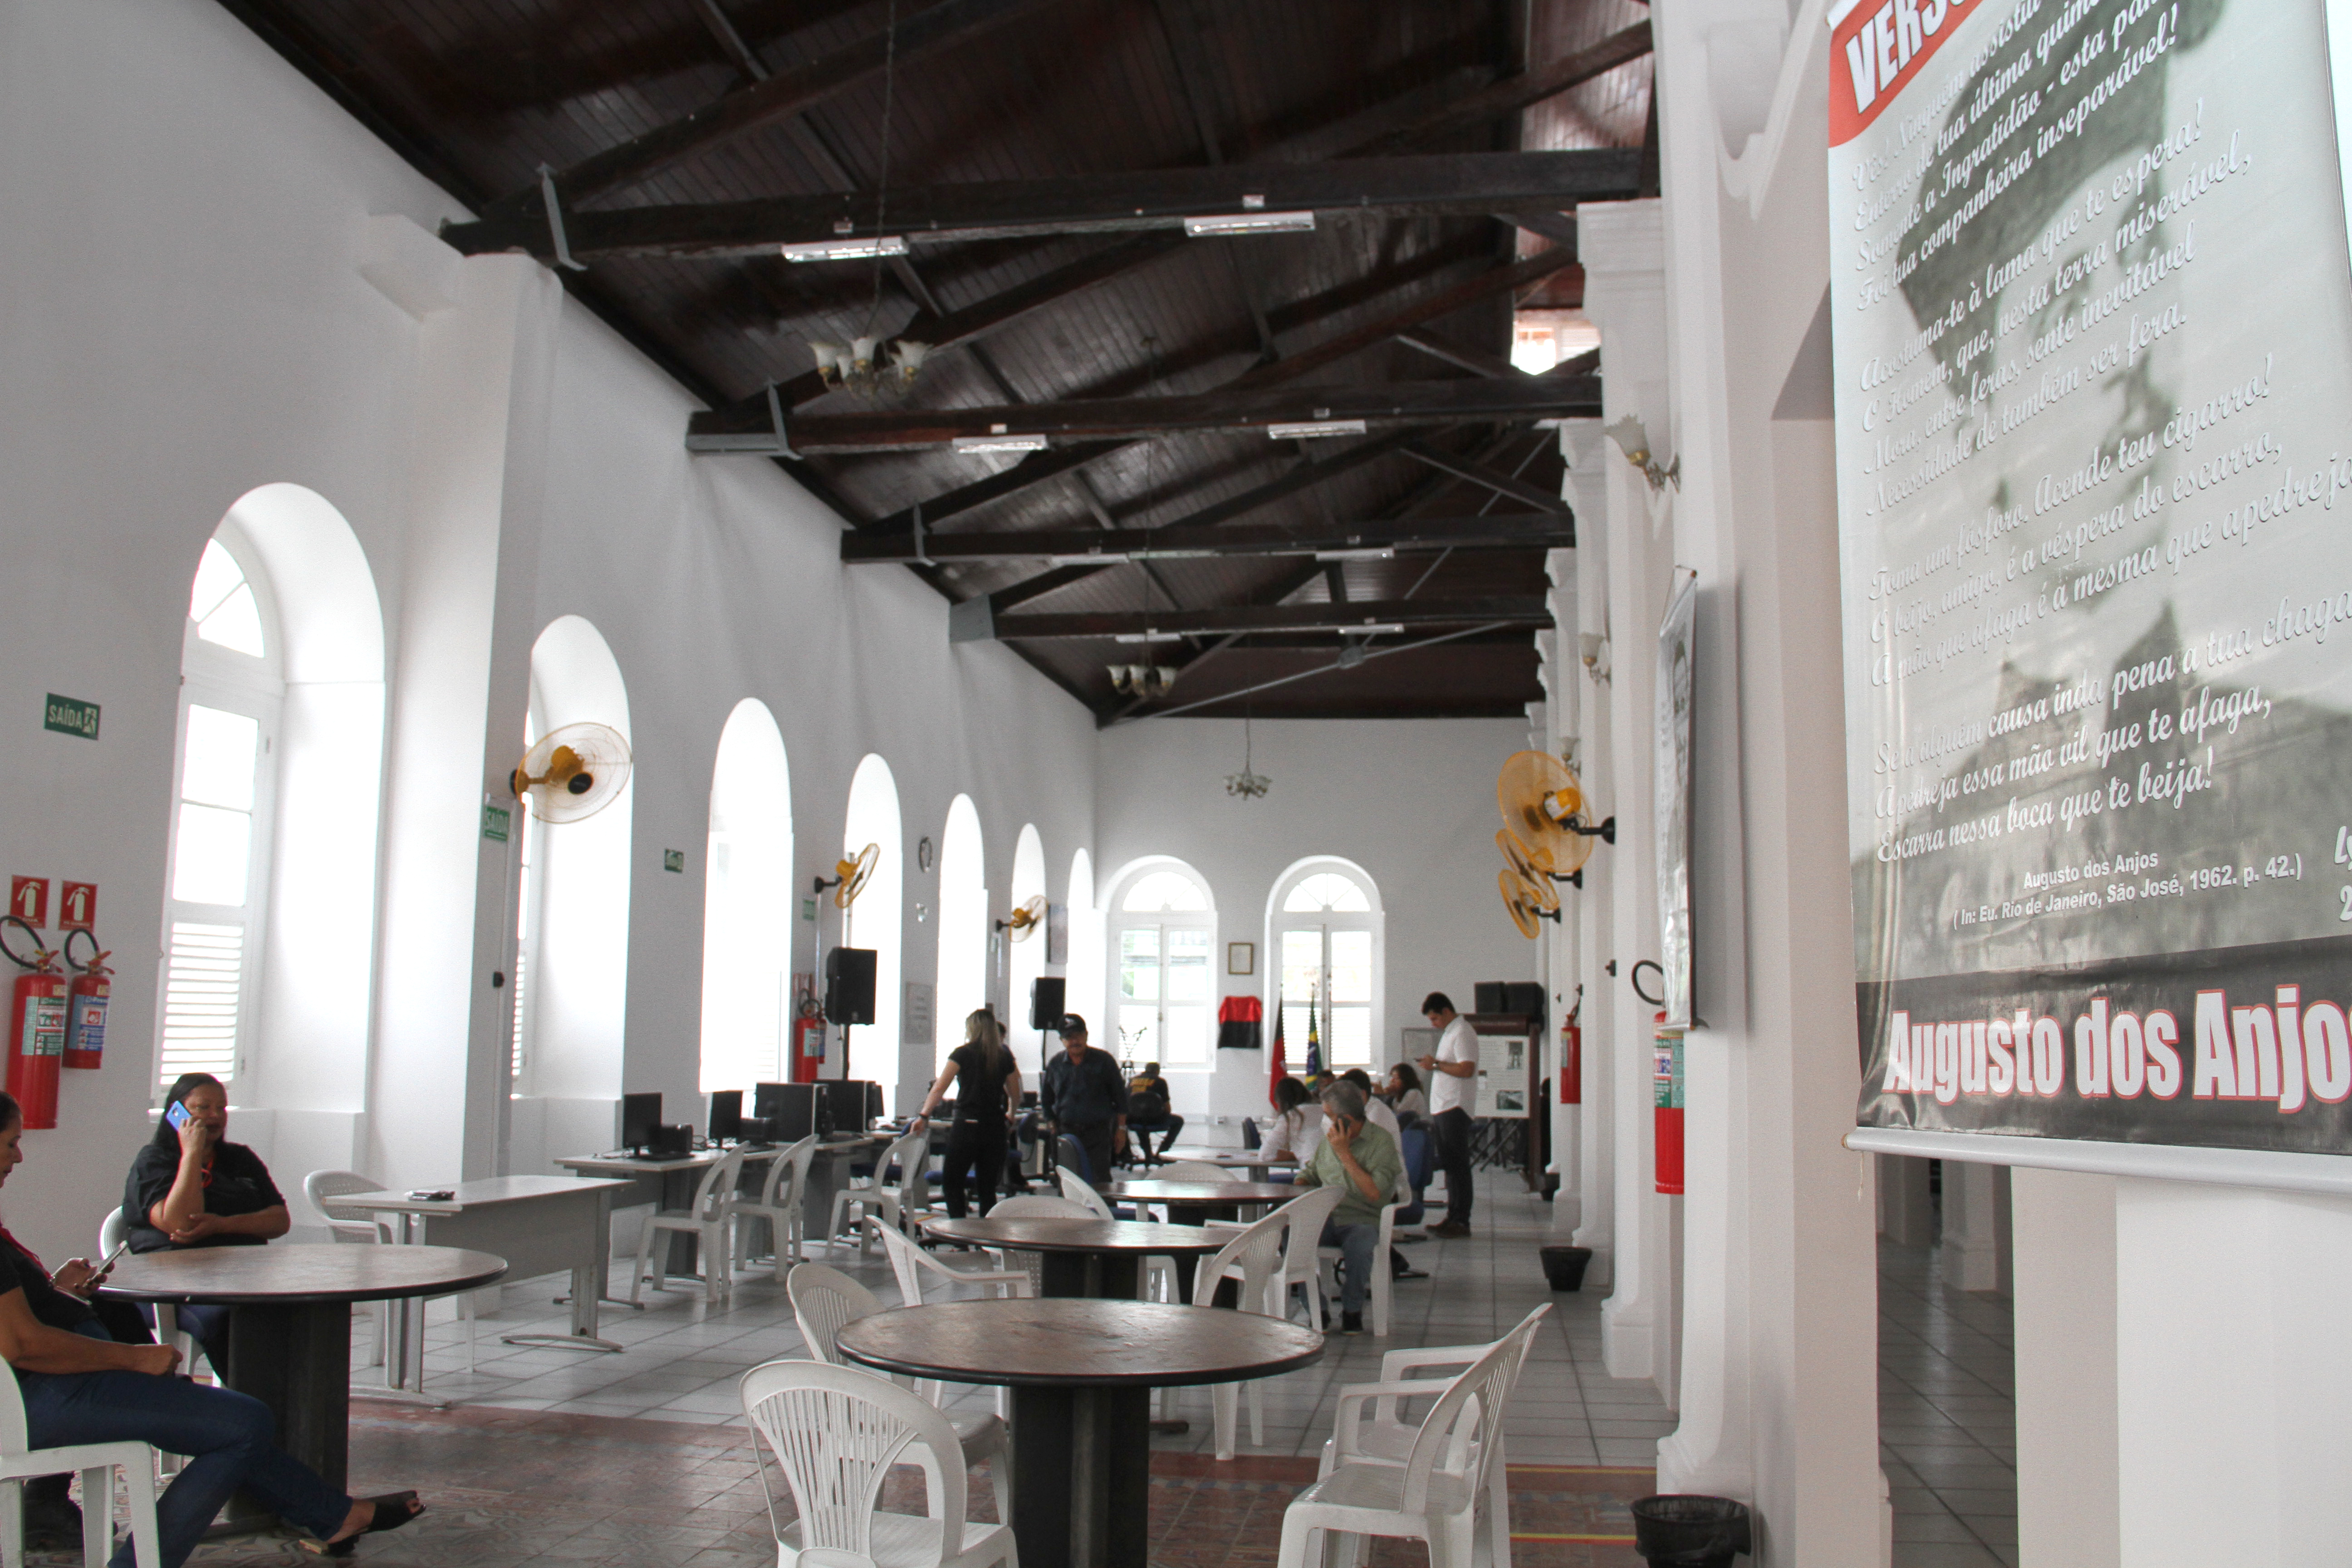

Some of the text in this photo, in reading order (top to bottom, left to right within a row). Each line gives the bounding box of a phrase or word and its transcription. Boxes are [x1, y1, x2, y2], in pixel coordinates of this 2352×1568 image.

[1857, 202, 1922, 270] Somente
[1925, 188, 1937, 213] a
[1941, 91, 2041, 197] Ingratidão
[2060, 29, 2107, 86] esta
[1857, 2, 2177, 310] Foi tua companheira inseparável!
[1916, 142, 1934, 179] de
[1937, 113, 1967, 156] tua
[1970, 48, 2033, 124] última
[2036, 0, 2100, 67] quim
[1861, 97, 2204, 391] Acostuma-te à lama que te espera!
[1862, 129, 2252, 432] O Homem, que, nesta terra miserável,
[1864, 218, 2197, 474] Mora, entre feras, sente inevitável
[1867, 302, 2187, 515] Necessidade de também ser fera.
[1868, 352, 2274, 600] Toma um fósforo. Acende teu cigarro!
[1894, 597, 1937, 637] beijo,
[1941, 569, 2000, 613] amigo,
[2006, 545, 2016, 581] é
[2021, 548, 2036, 574] a
[2041, 503, 2127, 565] véspera
[2132, 475, 2166, 521] do
[2172, 432, 2283, 502] escarro,
[1872, 653, 1891, 686] A
[1898, 644, 1931, 681] mão
[1936, 632, 1966, 672] que
[1971, 601, 2032, 653] afaga
[2037, 581, 2048, 617] é
[2052, 583, 2069, 611] a
[2073, 544, 2159, 602] mesma
[2166, 521, 2215, 576] que
[48, 704, 83, 729] SAÍDA
[1874, 741, 1899, 774] Se
[1920, 716, 1982, 768] alguém
[1987, 697, 2049, 738] causa
[2053, 668, 2106, 717] inda
[2112, 653, 2176, 710] pena
[2182, 645, 2200, 675] a
[2206, 627, 2254, 666] tua
[1875, 685, 2272, 825] Apedreja essa mão vil que te afaga,
[1877, 745, 2215, 862] Escarra nessa boca que te beija!
[1961, 909, 1976, 925] In:
[1979, 905, 1998, 922] Eu.
[2002, 900, 2022, 919] Rio
[2025, 897, 2042, 916] de
[2045, 890, 2102, 912] Janeiro,
[2107, 883, 2136, 903] São
[2139, 874, 2185, 899] José,
[2190, 865, 2237, 890] 1962.
[2243, 866, 2260, 888] p.
[2264, 853, 2303, 881] 42.)
[2023, 851, 2159, 890] Augusto dos Anjos
[1882, 983, 2352, 1114] Augusto dos Anjo
